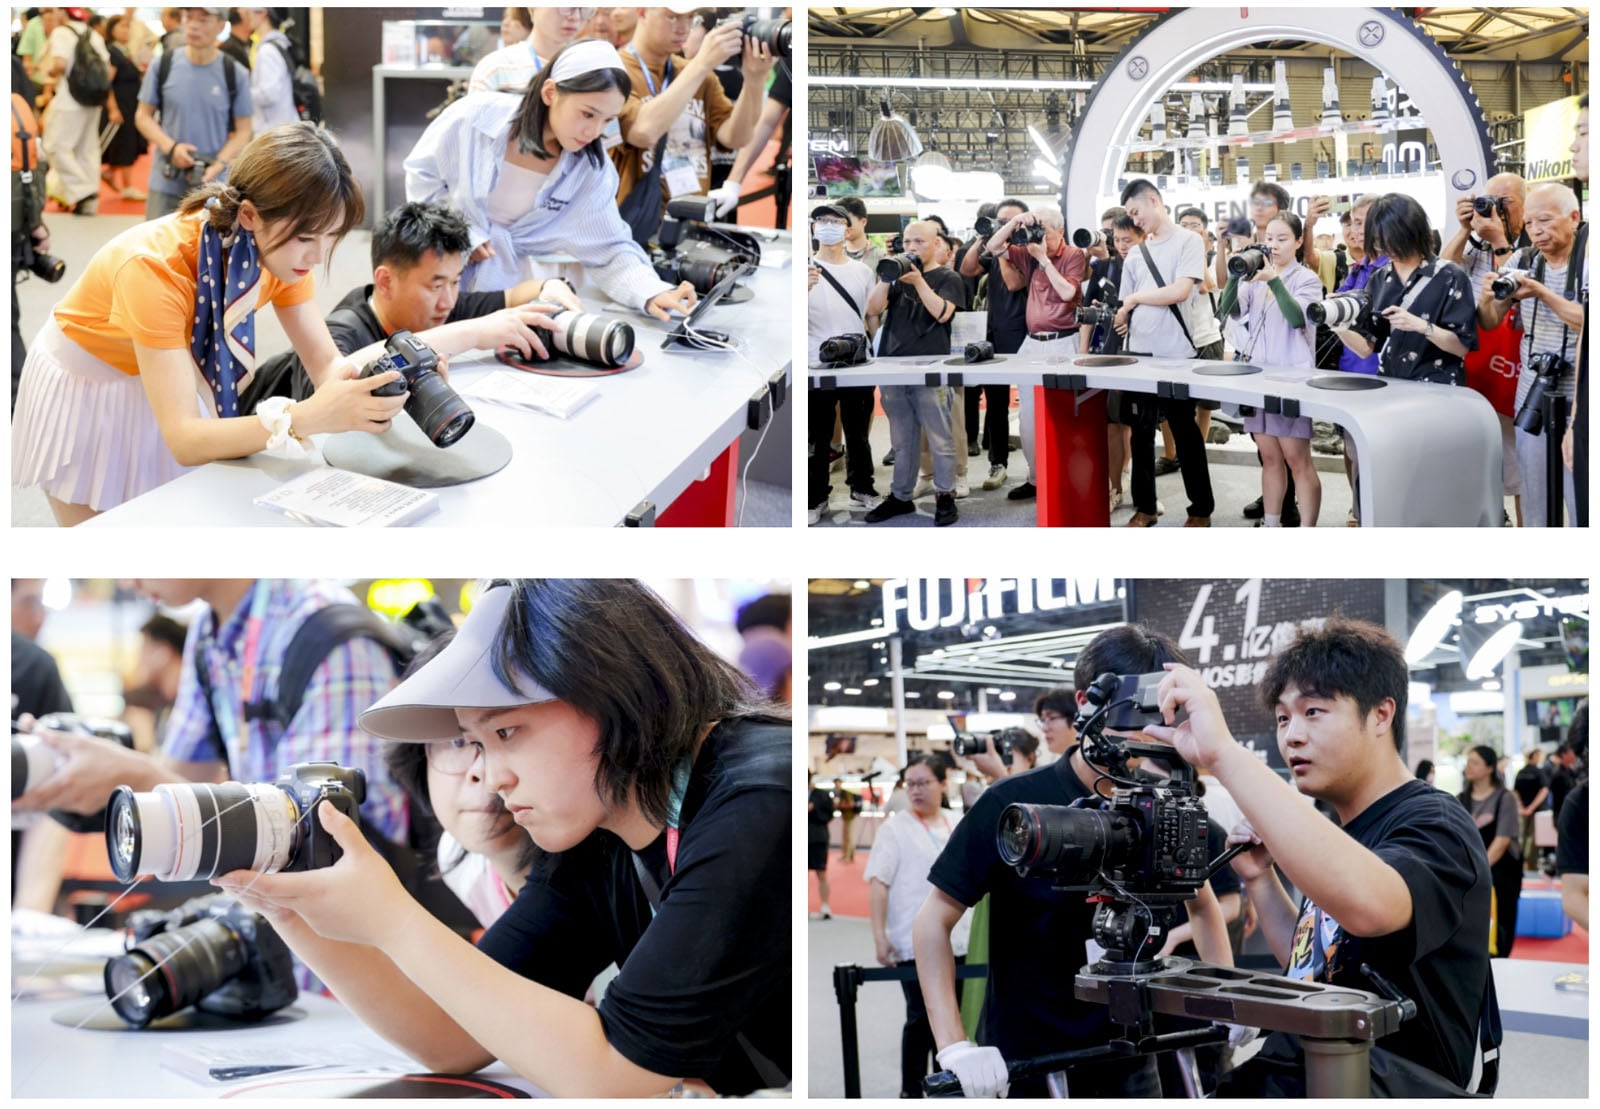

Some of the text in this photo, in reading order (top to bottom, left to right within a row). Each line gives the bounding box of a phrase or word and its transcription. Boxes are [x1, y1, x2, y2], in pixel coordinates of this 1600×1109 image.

[1527, 160, 1571, 181] Nikon
[882, 578, 1117, 632] FUJIFILM
[1178, 578, 1262, 664] 4.1
